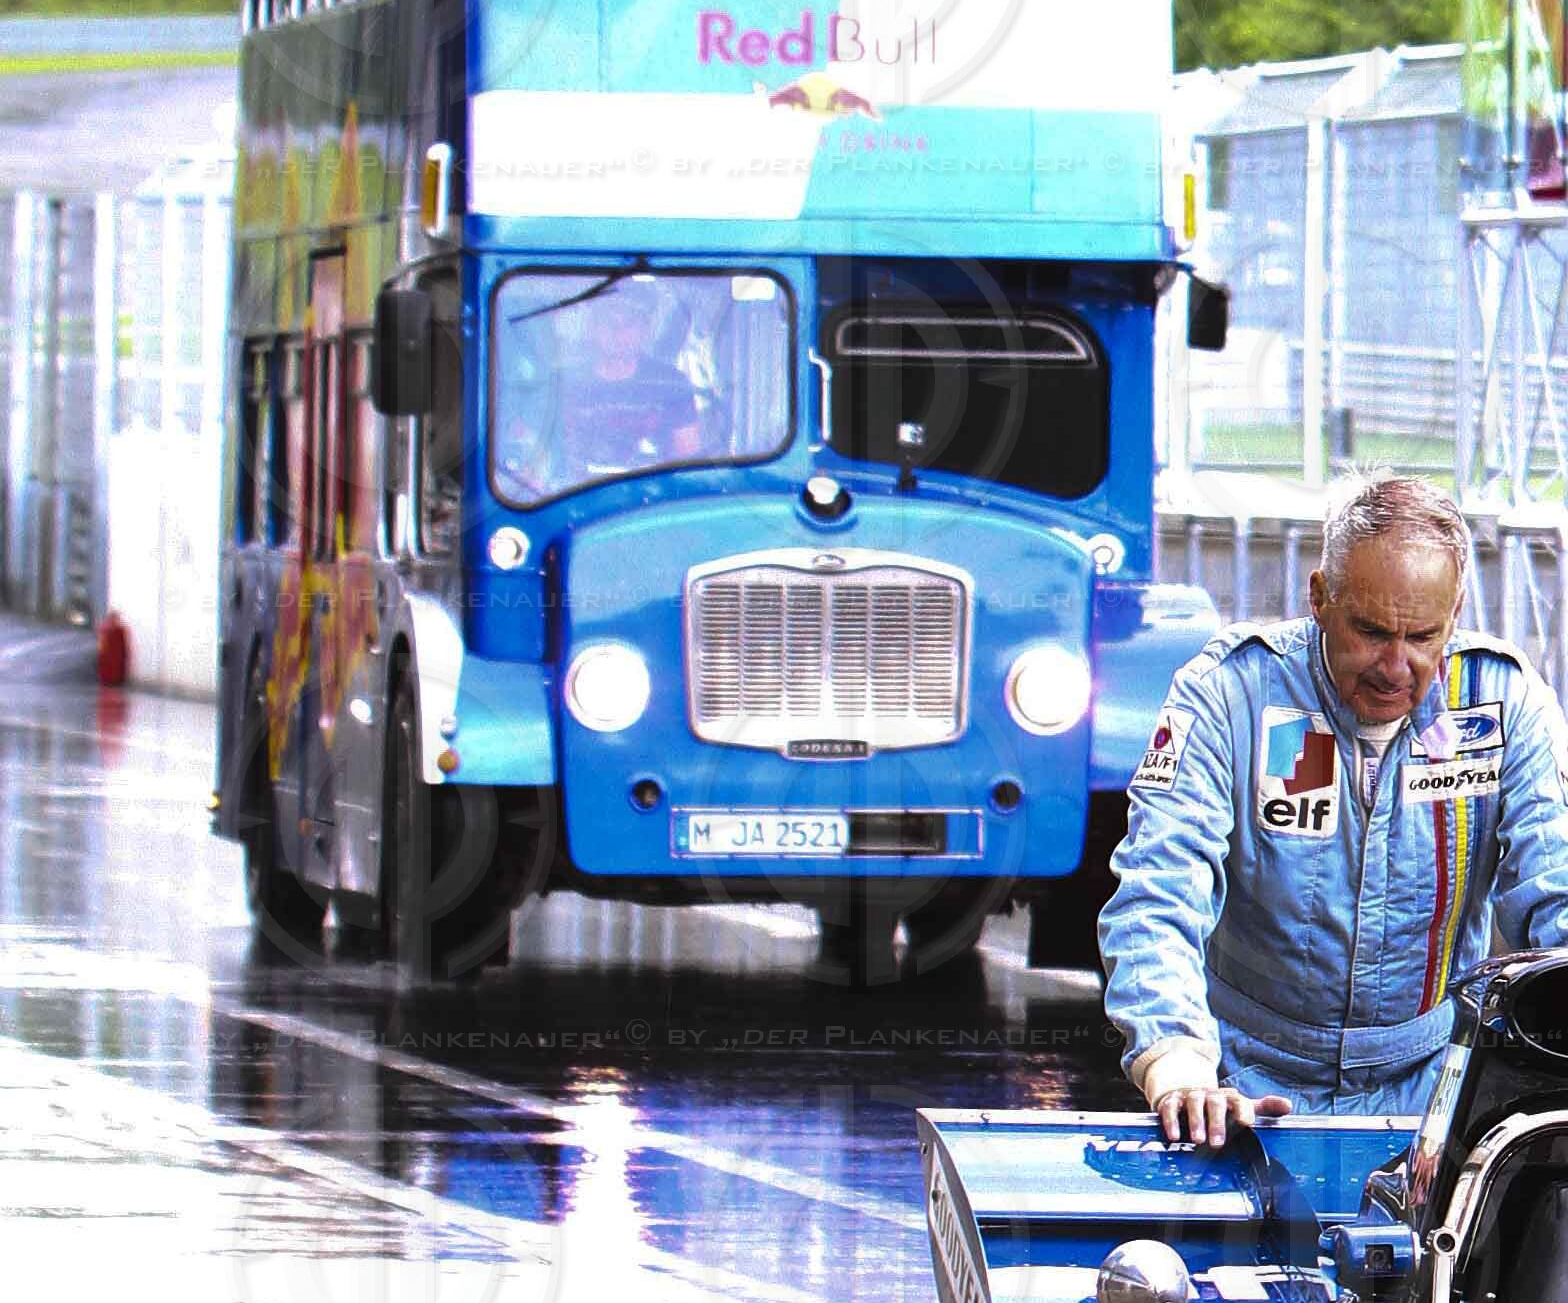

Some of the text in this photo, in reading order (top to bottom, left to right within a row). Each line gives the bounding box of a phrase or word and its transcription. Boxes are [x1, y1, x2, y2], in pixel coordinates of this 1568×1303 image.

[696, 9, 937, 67] Red Bull
[1263, 796, 1331, 831] elf
[693, 820, 844, 848] M JA 2521
